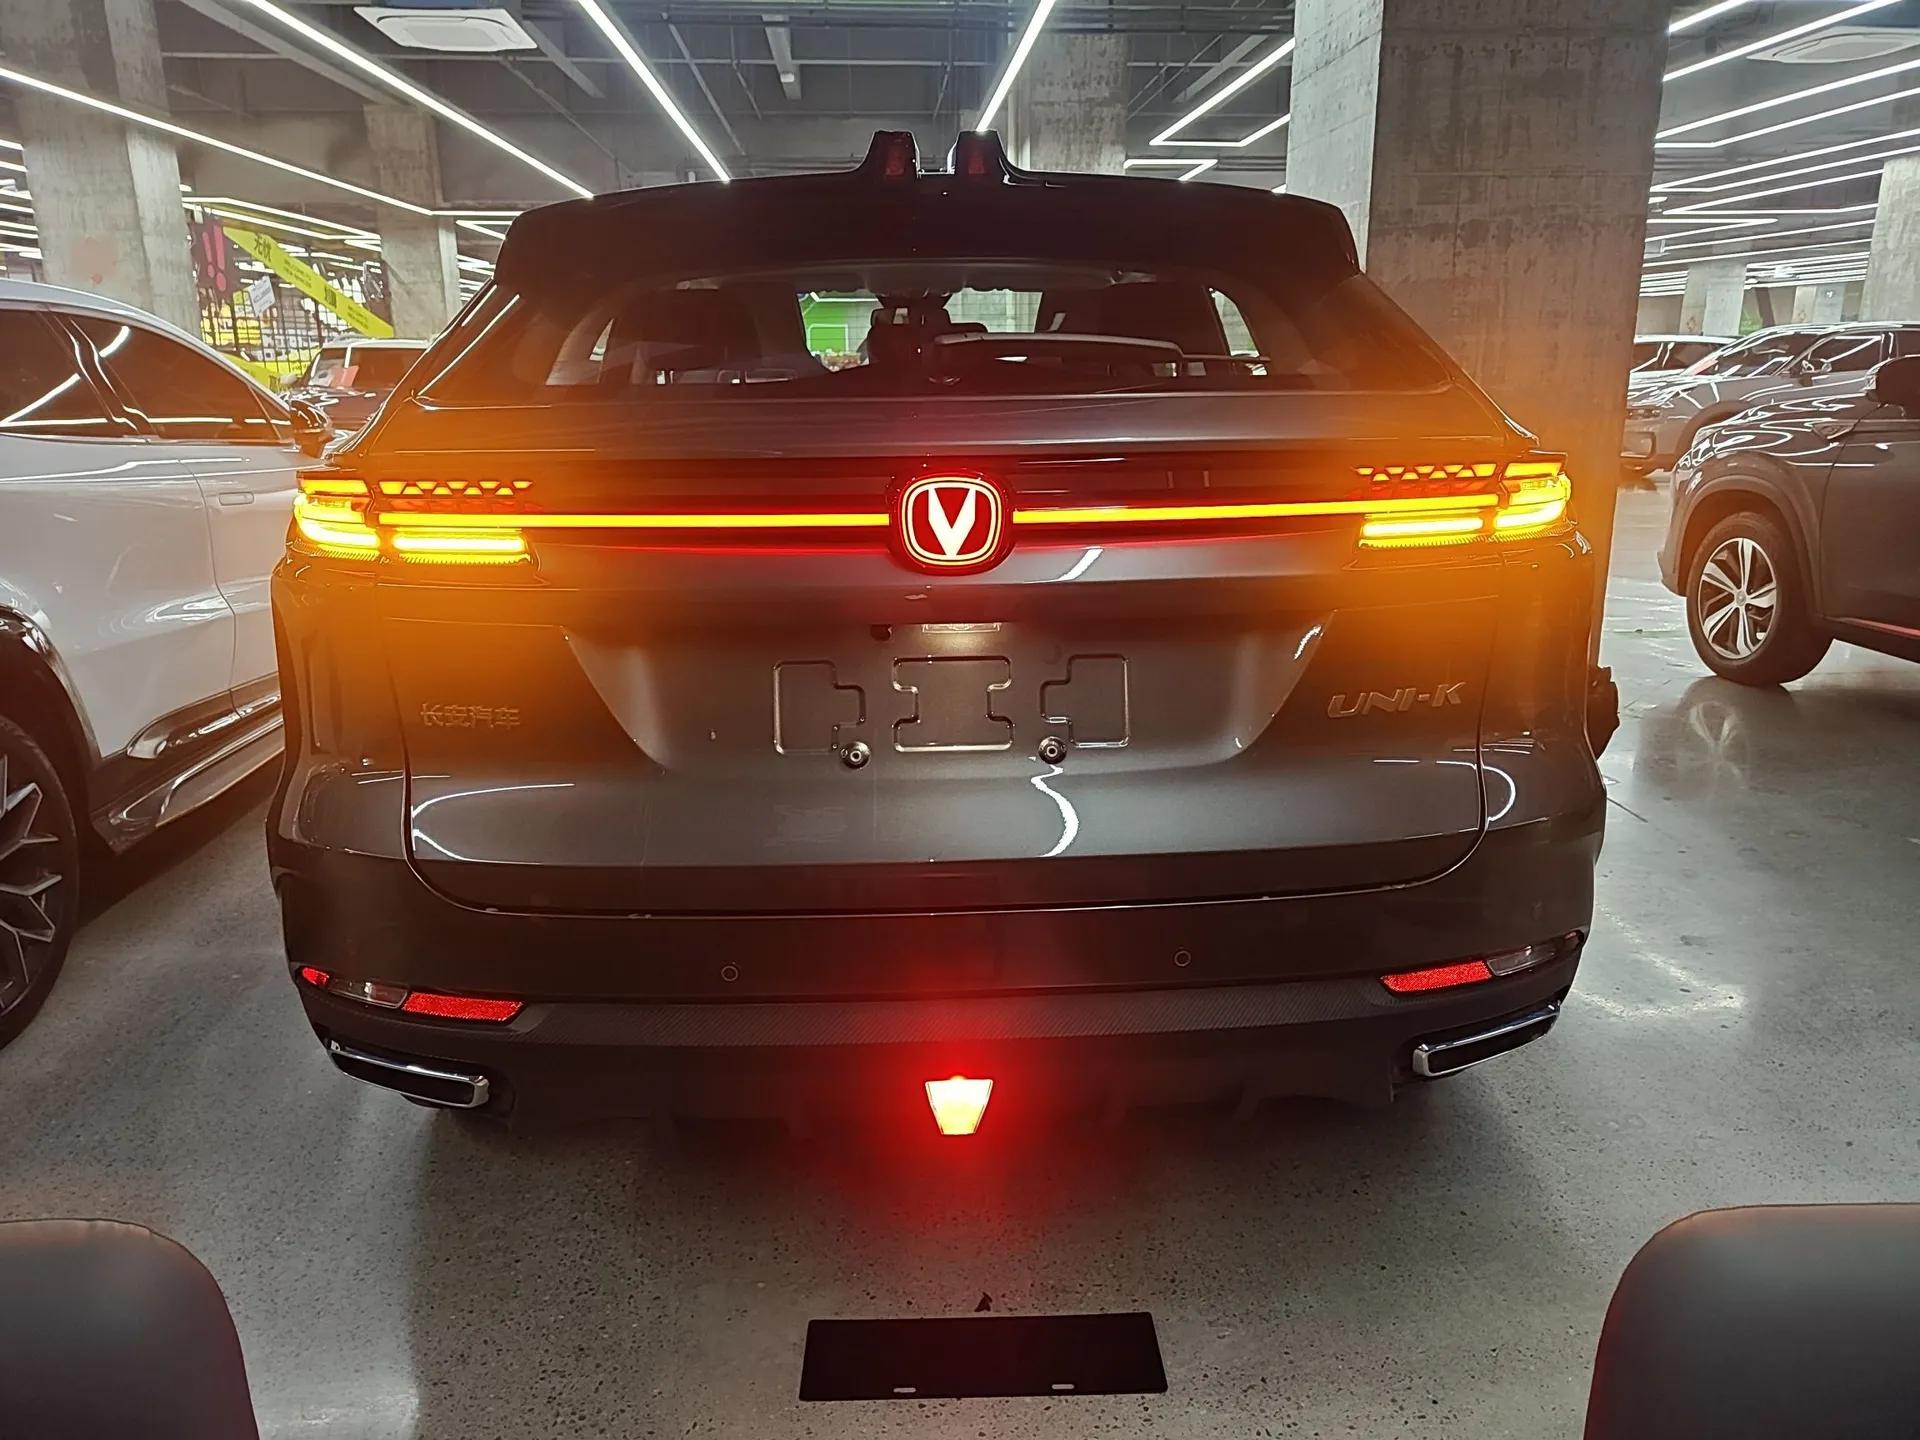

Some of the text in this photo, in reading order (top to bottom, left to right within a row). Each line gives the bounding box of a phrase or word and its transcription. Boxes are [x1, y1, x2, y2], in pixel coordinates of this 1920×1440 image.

[1328, 681, 1466, 718] UNI-K
[420, 703, 520, 730] 长安汽车
